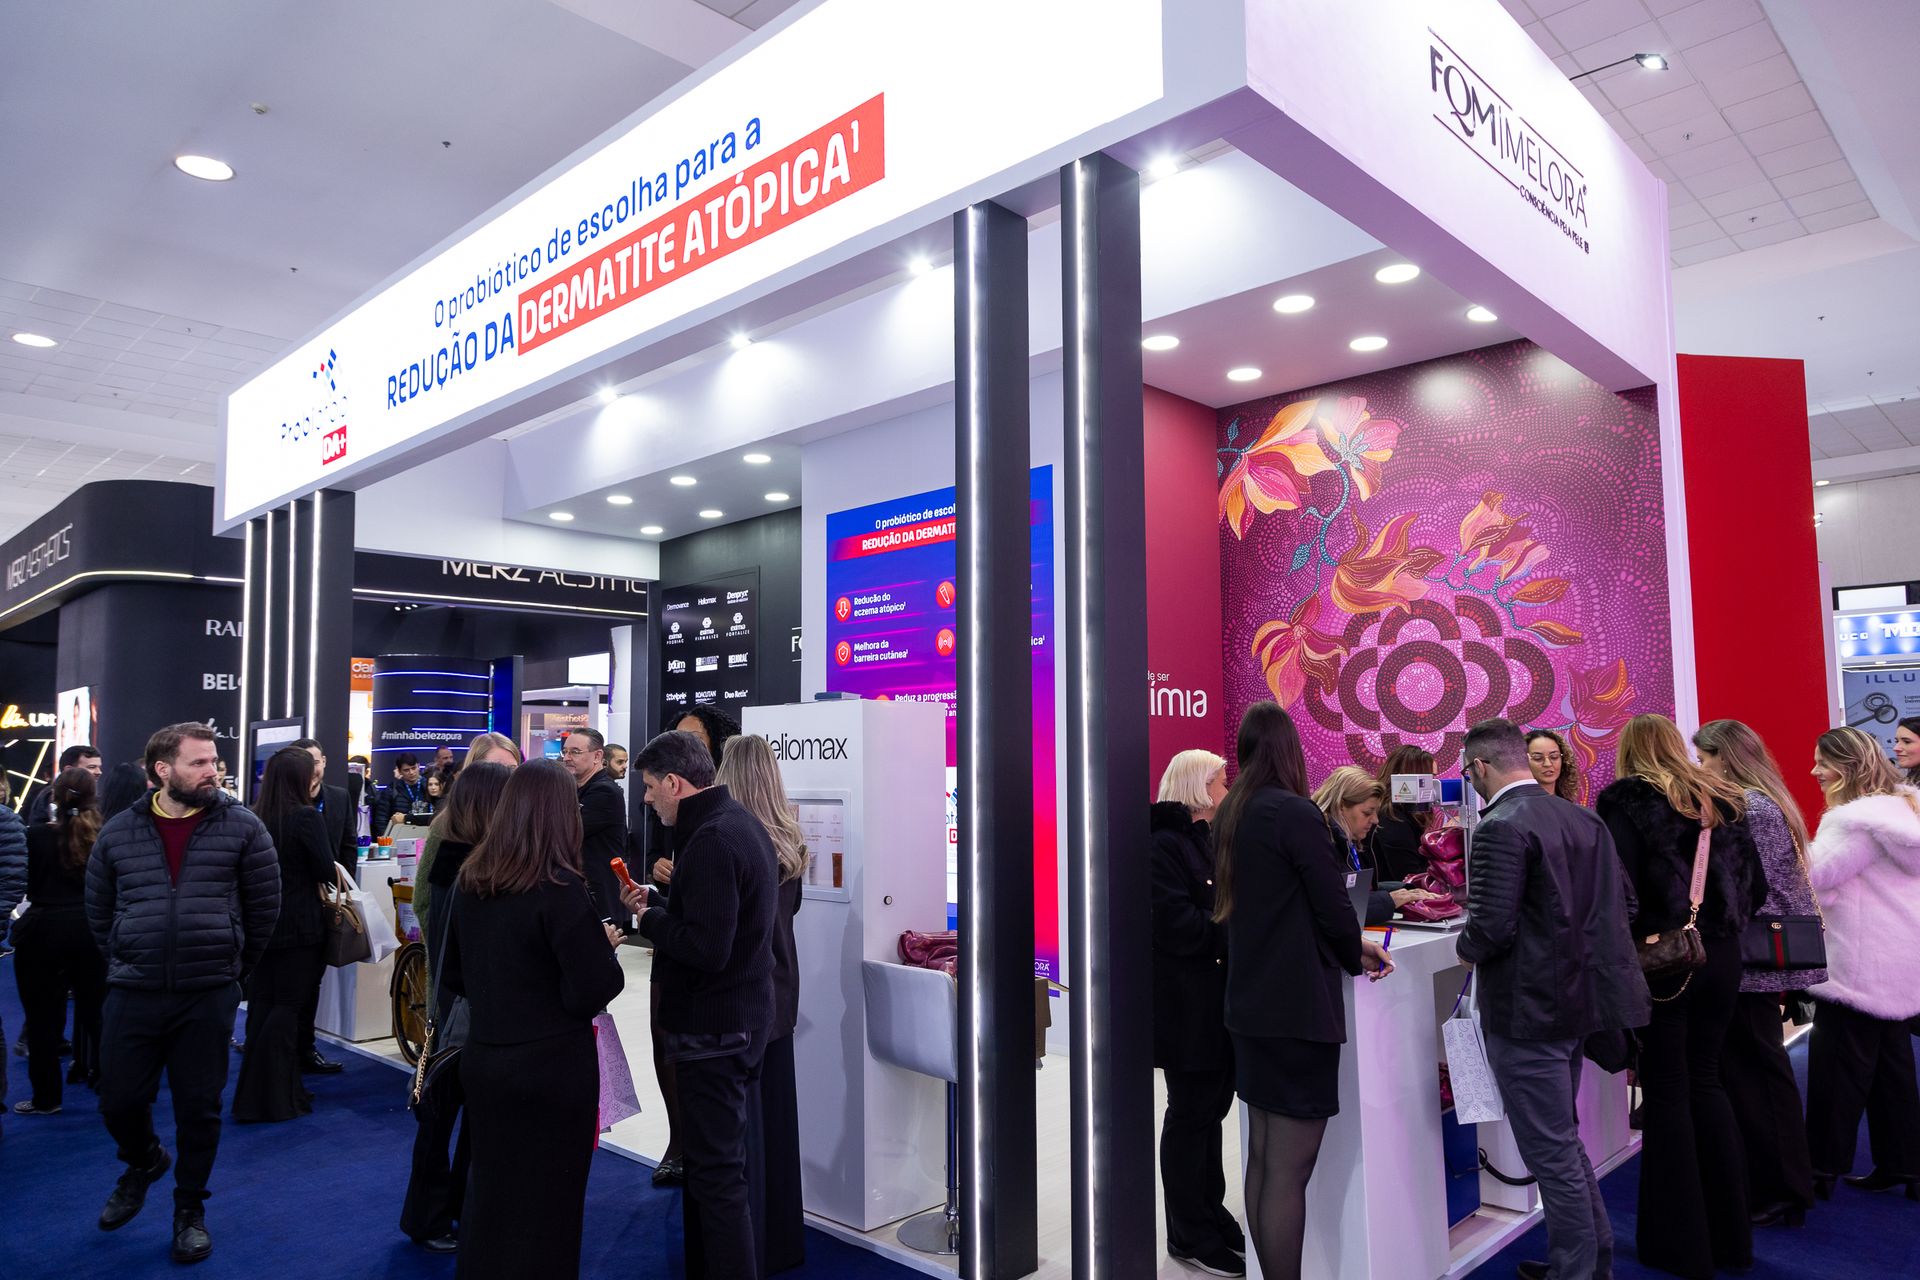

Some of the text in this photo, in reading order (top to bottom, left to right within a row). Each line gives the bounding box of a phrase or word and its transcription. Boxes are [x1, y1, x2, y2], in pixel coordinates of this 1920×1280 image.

[1430, 44, 1497, 146] FQM
[435, 117, 761, 330] O probiótico de escolha para a
[387, 330, 478, 410] REDUÇÃO
[484, 312, 515, 361] DA
[521, 221, 676, 345] DERMATITE
[875, 519, 881, 529] O
[882, 511, 922, 530] probiótico
[923, 507, 933, 520] de
[862, 530, 901, 551] REDUÇÃO
[902, 531, 915, 543] DA
[854, 592, 891, 606] Redução do
[854, 606, 878, 617] eczema
[854, 639, 889, 652] Melhora da
[854, 654, 879, 664] barreira
[1157, 672, 1170, 682] ser
[381, 730, 462, 742] #minhabelezapura
[766, 733, 849, 761] eliomax
